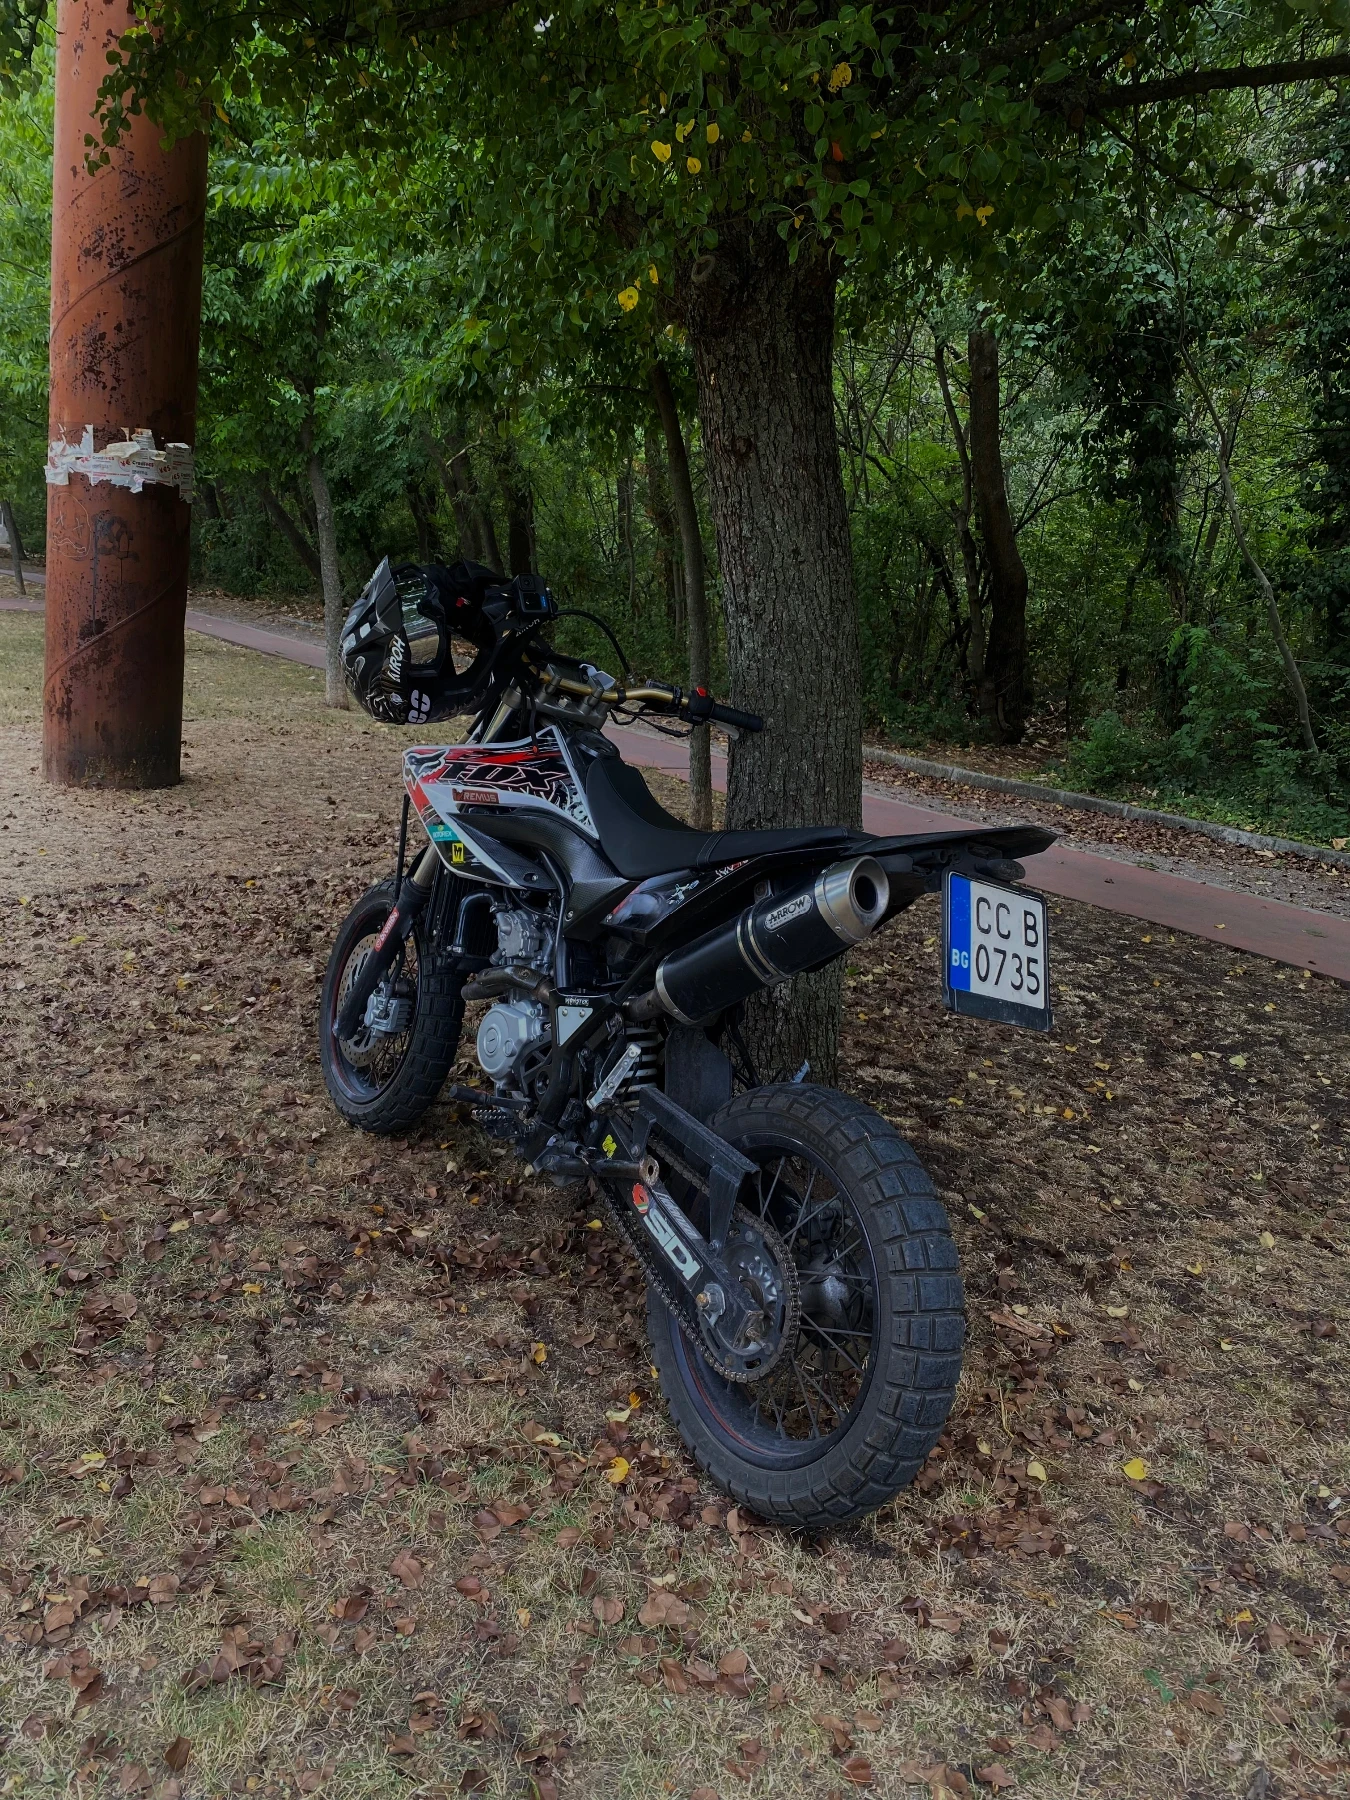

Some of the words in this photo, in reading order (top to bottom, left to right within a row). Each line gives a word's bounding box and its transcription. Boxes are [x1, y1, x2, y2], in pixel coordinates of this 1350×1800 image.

[387, 634, 406, 683] AIROH
[439, 760, 568, 791] FOX
[463, 791, 497, 804] REMUS
[769, 896, 806, 924] ARROW
[976, 897, 1011, 940] CC
[1023, 909, 1039, 947] B
[952, 948, 968, 969] BG
[975, 943, 1040, 995] 0735
